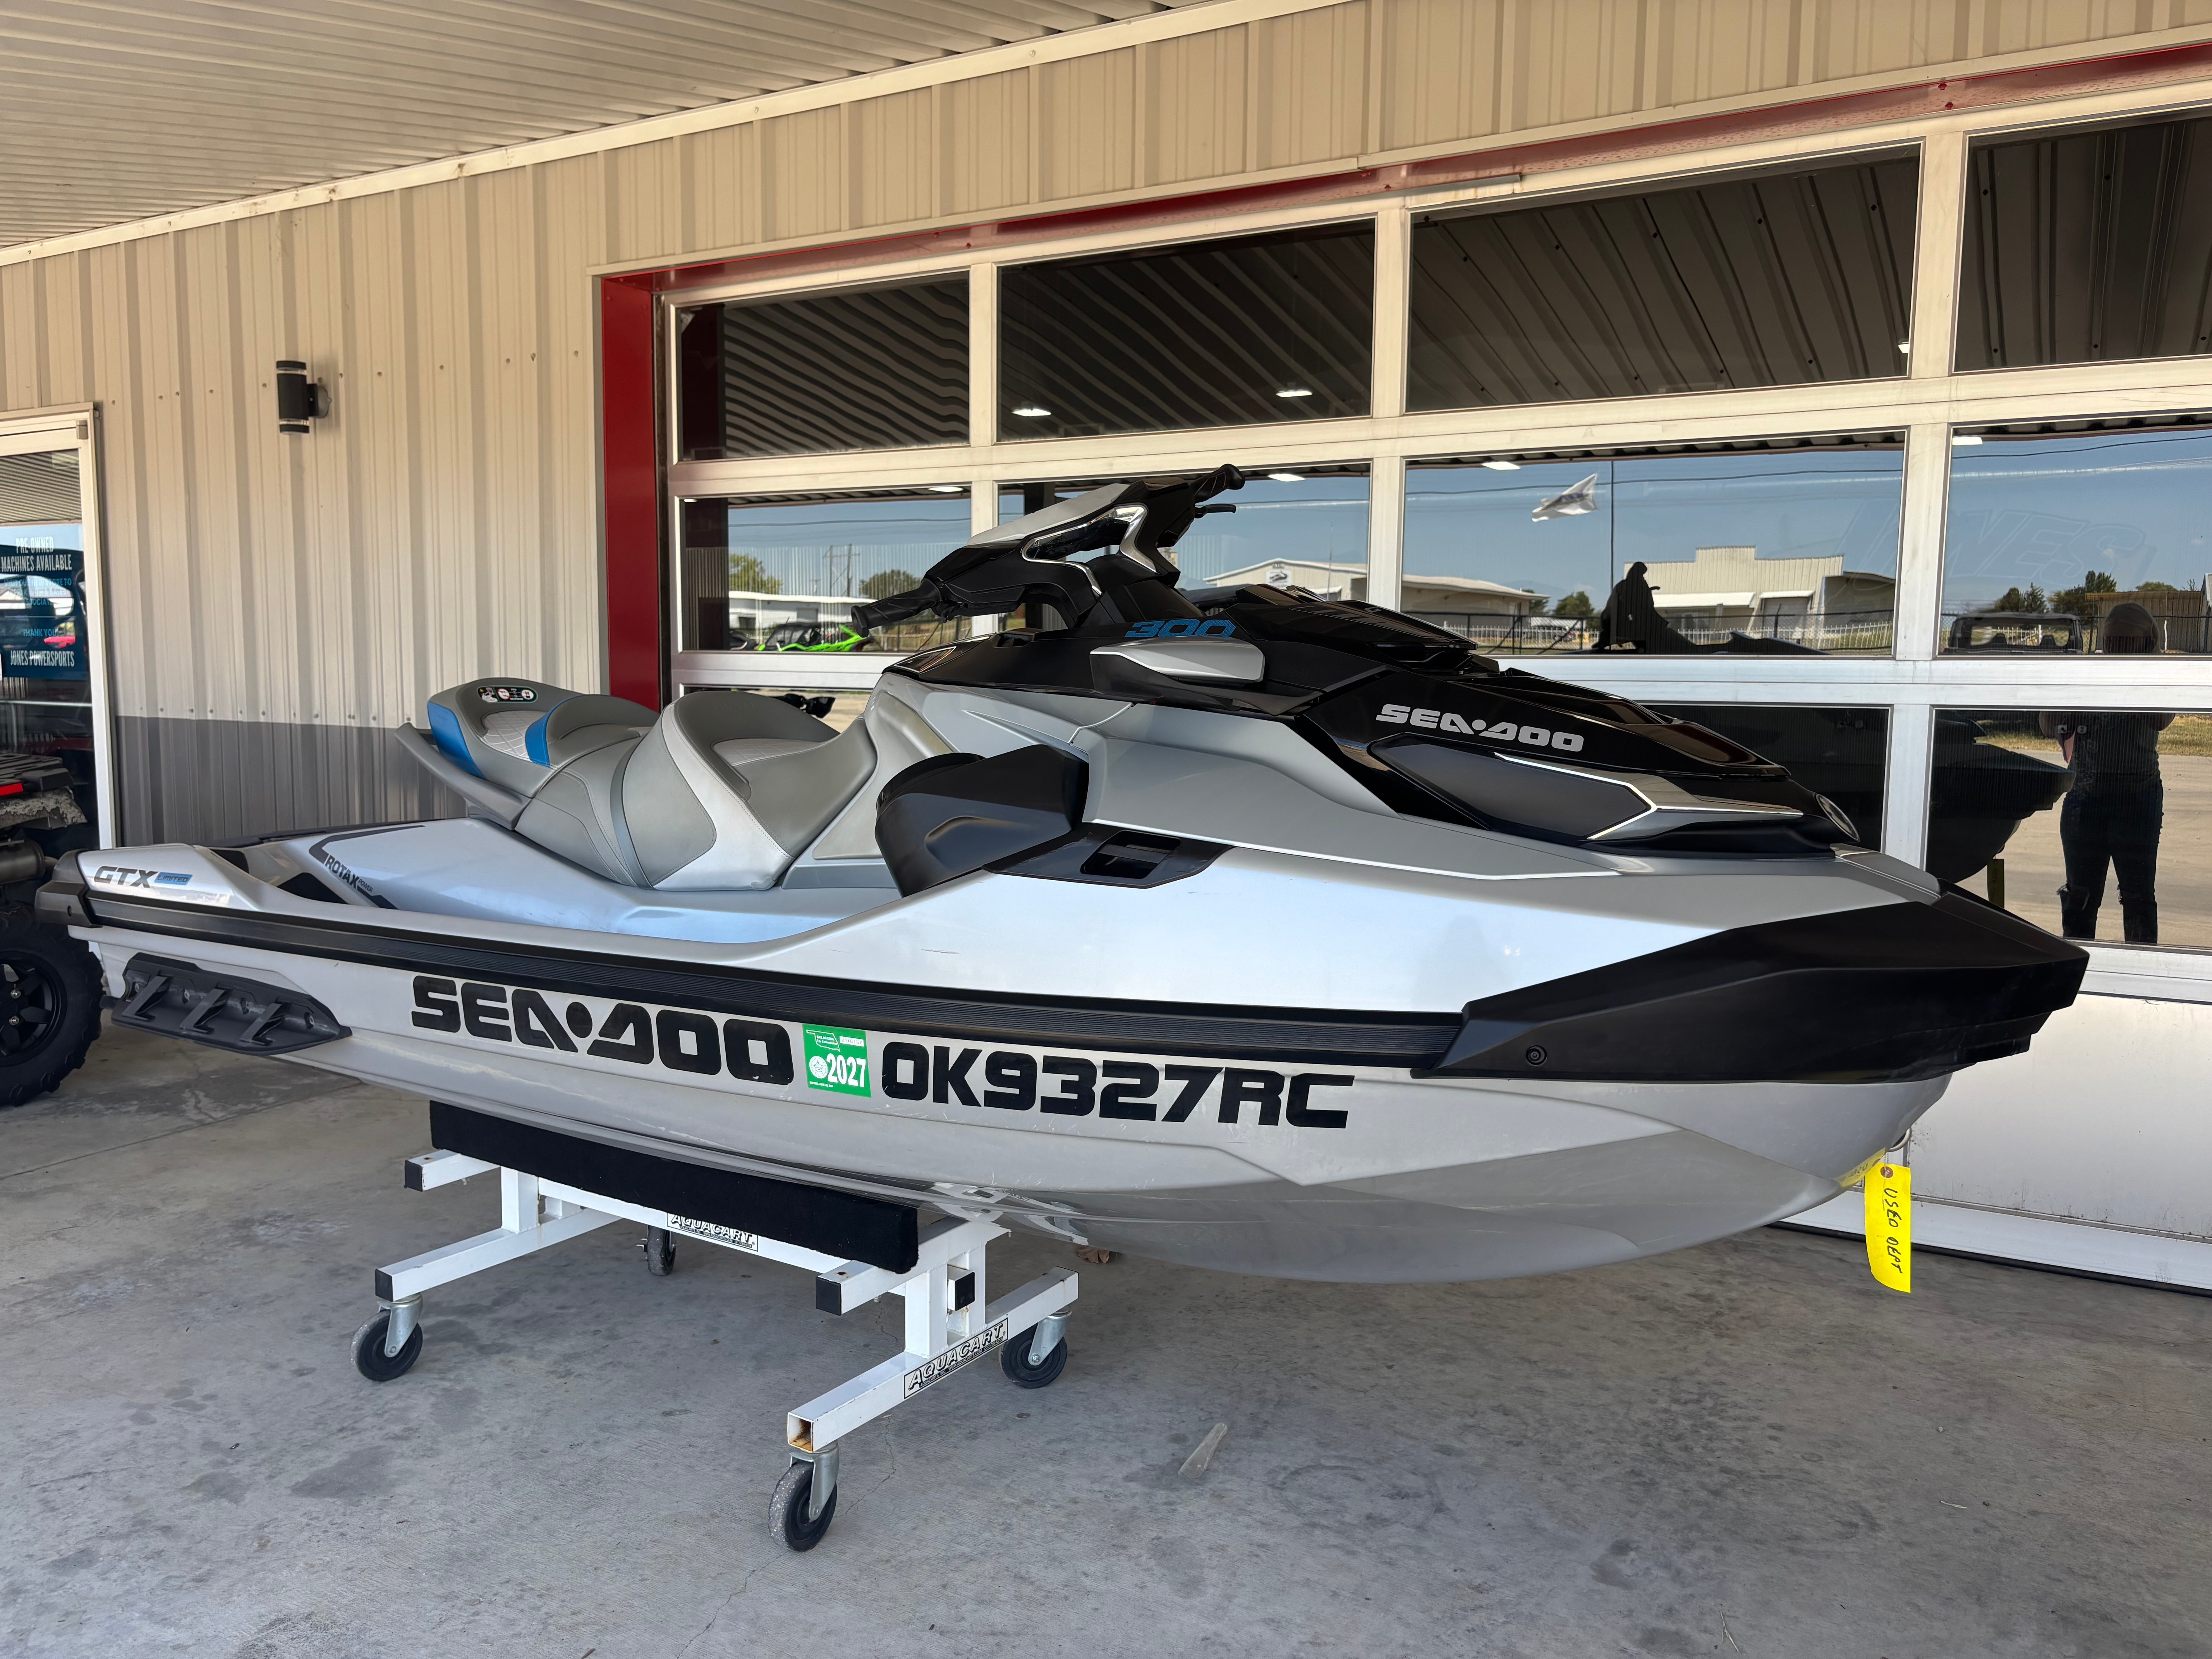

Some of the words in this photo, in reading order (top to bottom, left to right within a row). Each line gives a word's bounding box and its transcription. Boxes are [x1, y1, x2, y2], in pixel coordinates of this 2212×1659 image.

[16, 536, 54, 554] PRE-OWNED
[1, 555, 34, 572] MACHINES
[36, 554, 72, 571] AVAILABLE
[1125, 619, 1236, 638] 300
[11, 650, 28, 666] JONES
[29, 650, 75, 667] POWERSPORTS
[94, 866, 158, 888] GTX
[157, 874, 189, 883] LIMITED
[325, 855, 359, 890] ROTAX
[358, 878, 373, 893] POWER
[826, 1053, 866, 1087] 2027
[883, 1041, 1355, 1129] OK9327RC
[1883, 1188, 1902, 1228] USED
[671, 1214, 752, 1243] AQUACART
[1886, 1237, 1903, 1274] DEPT
[908, 1322, 1003, 1391] AQUACART
